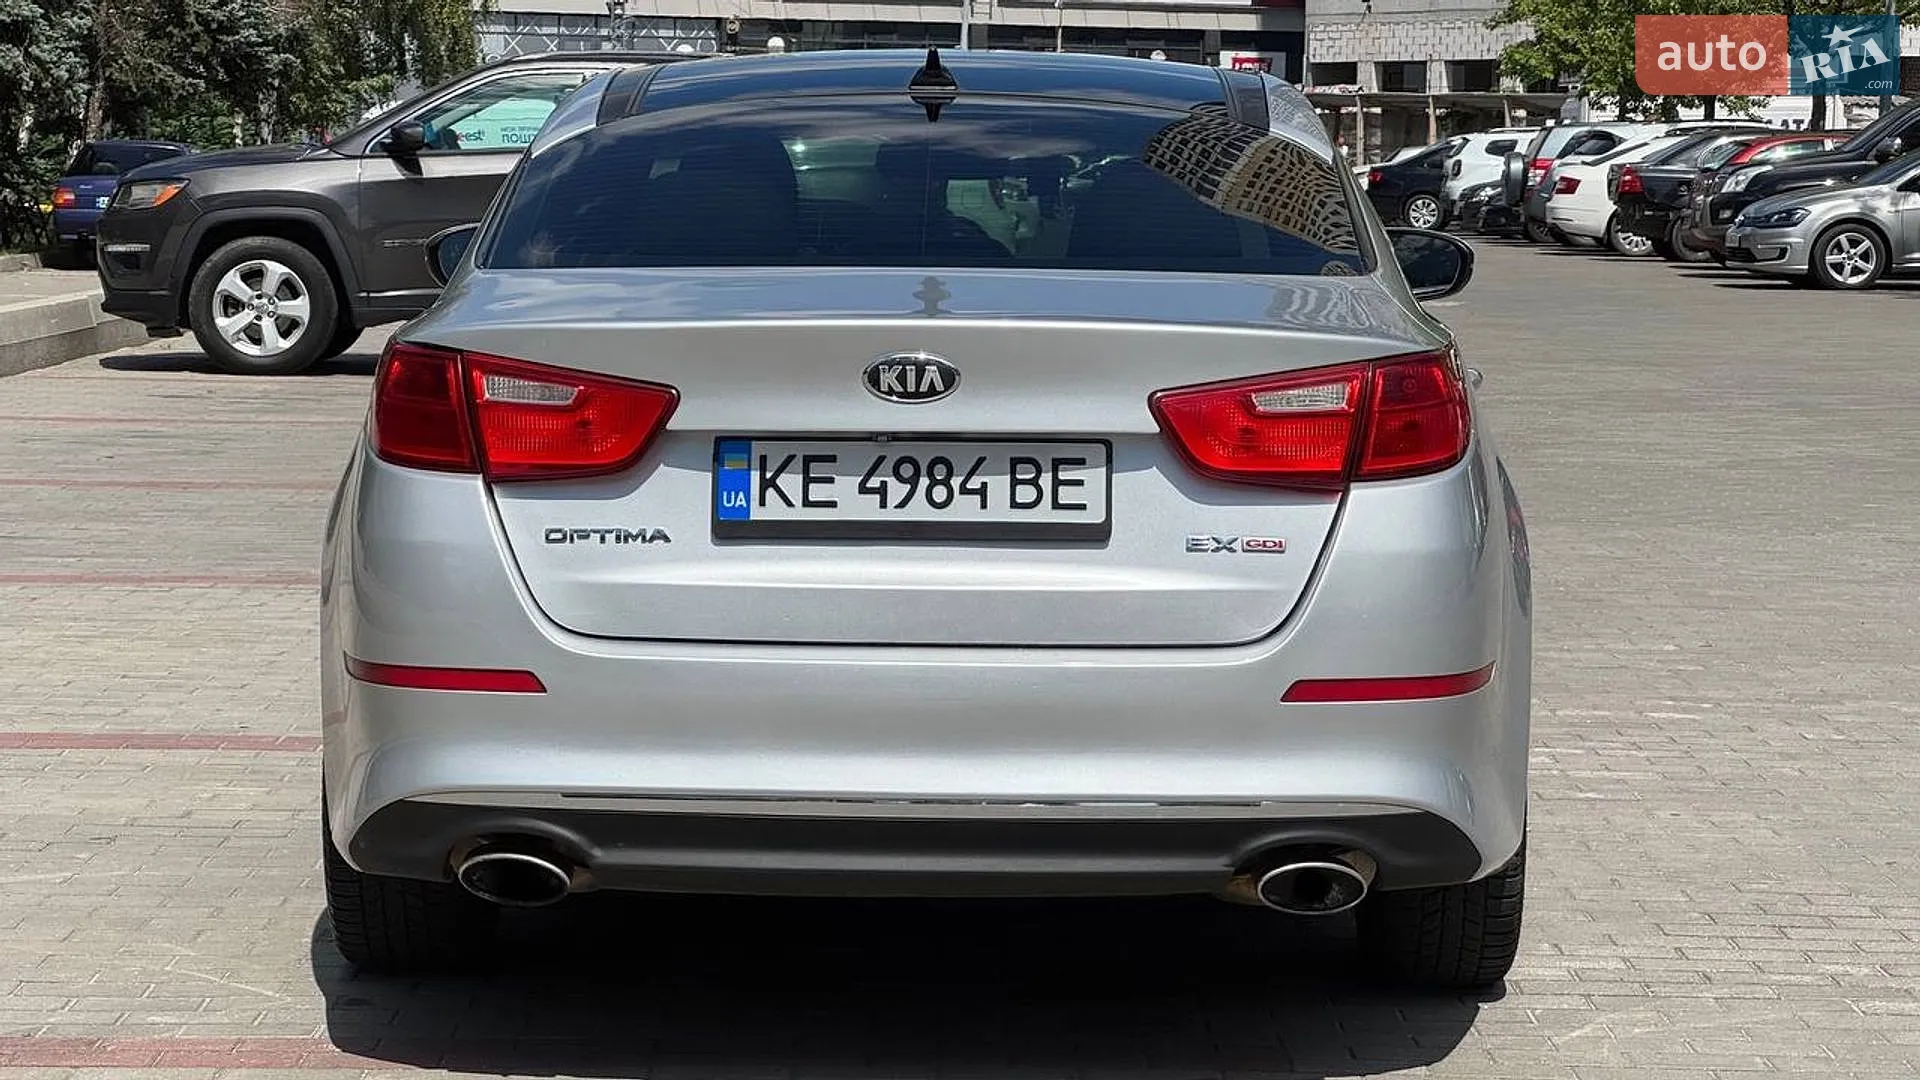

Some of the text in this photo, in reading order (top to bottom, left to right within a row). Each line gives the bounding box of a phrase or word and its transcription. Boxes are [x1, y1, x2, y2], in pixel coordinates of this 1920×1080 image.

[878, 364, 945, 392] KIA
[758, 454, 1088, 511] KE 4984 BE
[722, 491, 747, 508] UA
[544, 527, 672, 544] OPTIMA
[1185, 535, 1284, 553] EX GDI
